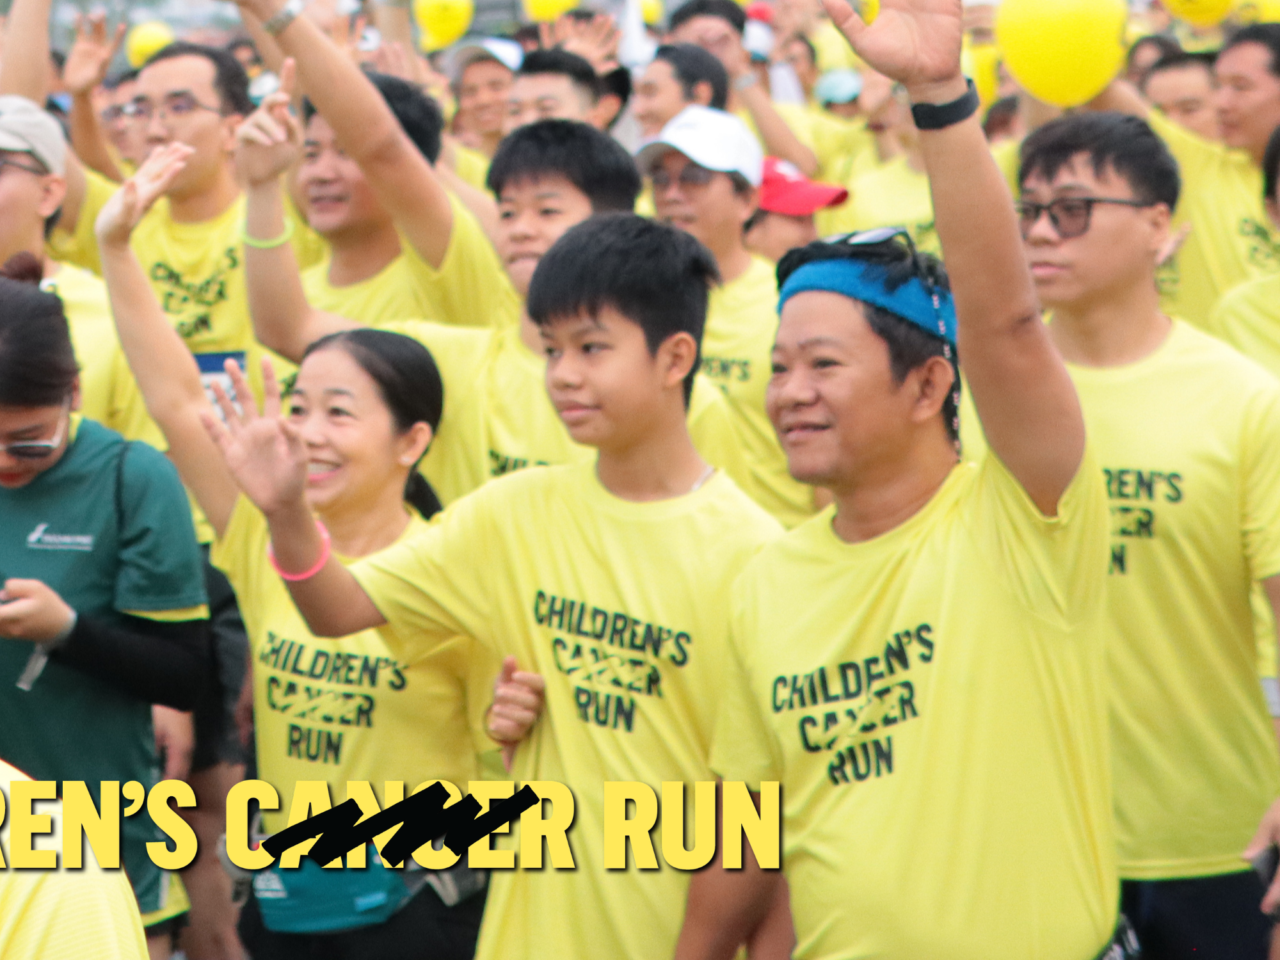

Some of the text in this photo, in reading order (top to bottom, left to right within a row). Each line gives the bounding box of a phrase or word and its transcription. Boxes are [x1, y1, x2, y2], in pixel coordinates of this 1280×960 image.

[534, 590, 692, 667] CHILDREN'S
[575, 686, 636, 733] RUN
[798, 680, 919, 754] CAER
[287, 723, 344, 765] RUN
[827, 735, 894, 786] RUN
